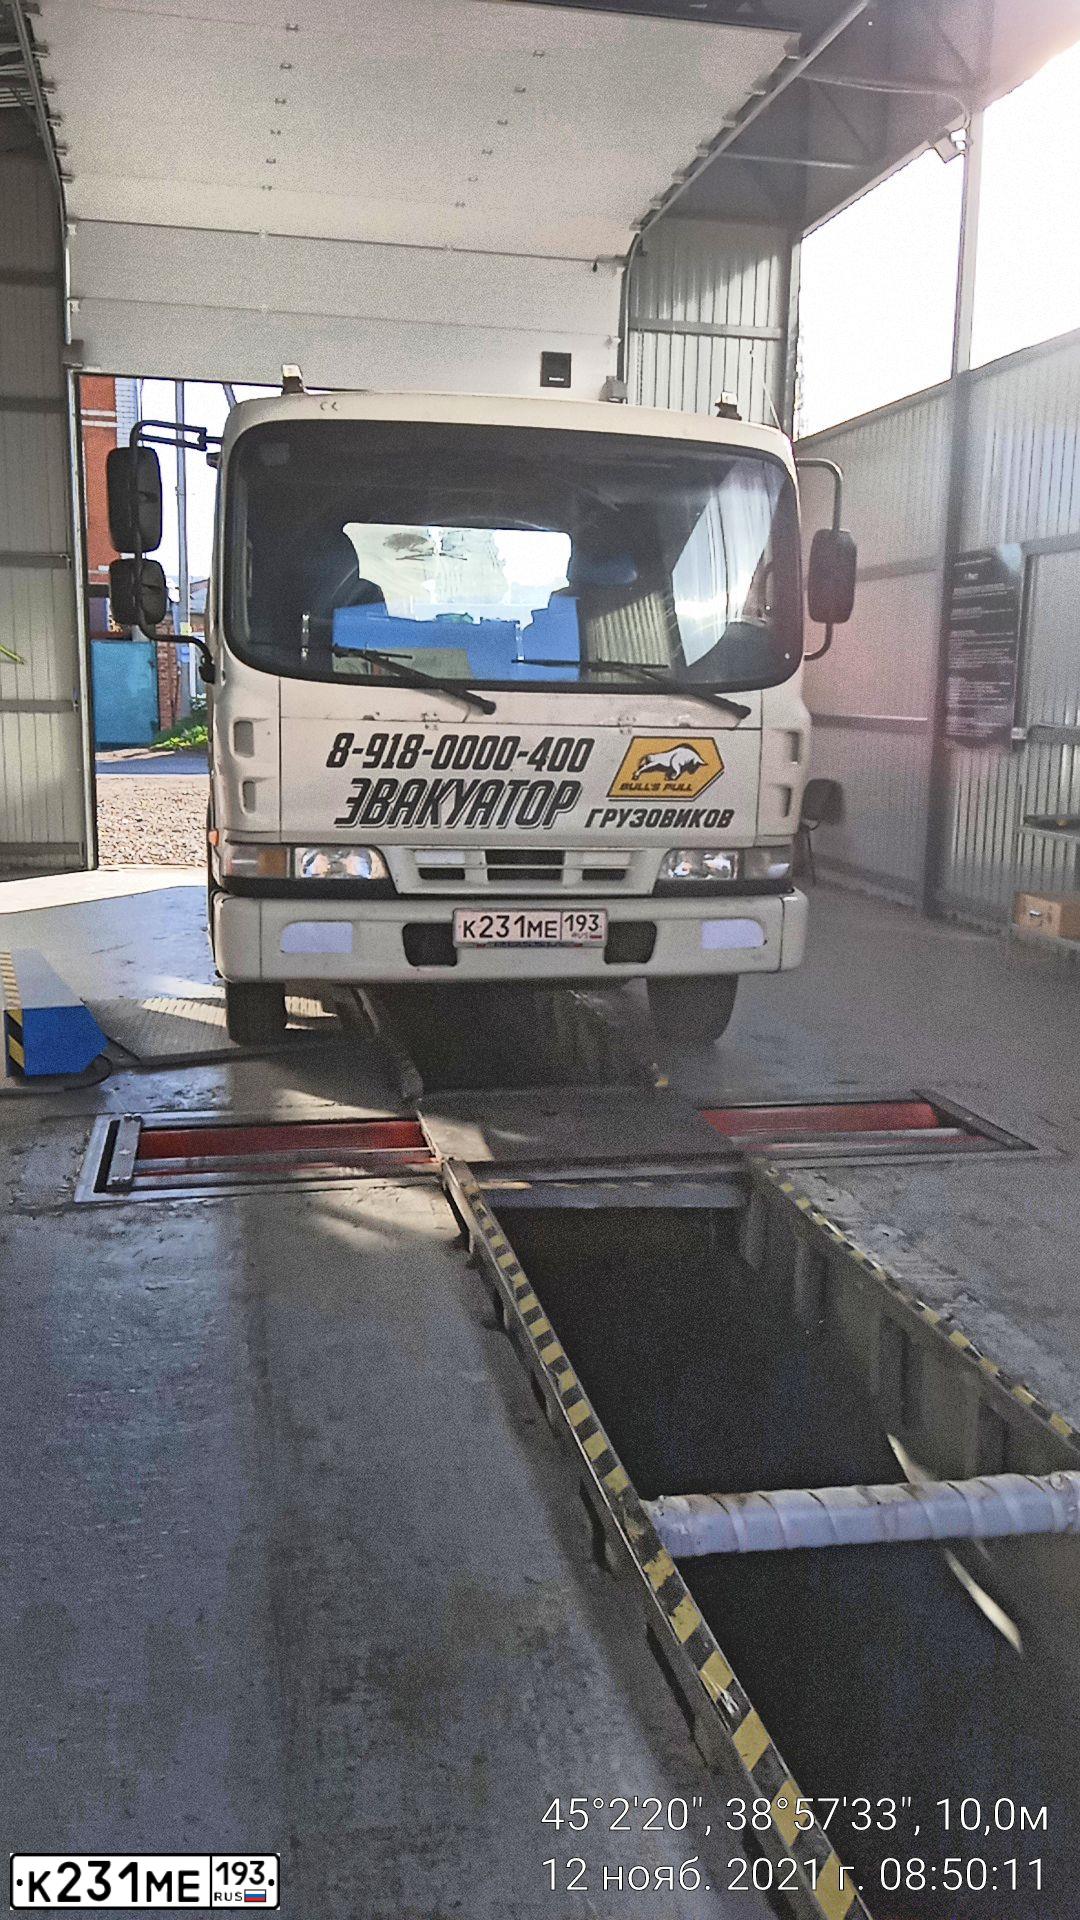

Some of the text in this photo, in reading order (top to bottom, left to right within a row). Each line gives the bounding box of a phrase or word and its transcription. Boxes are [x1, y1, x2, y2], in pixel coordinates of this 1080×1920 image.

[326, 732, 595, 773] 8-918-0000-400
[619, 783, 693, 792] BULL'S PULL
[333, 777, 582, 829] ЭВАКУАТОР
[584, 808, 735, 829] ГРУЗОВИКОВ
[564, 914, 600, 932] 193
